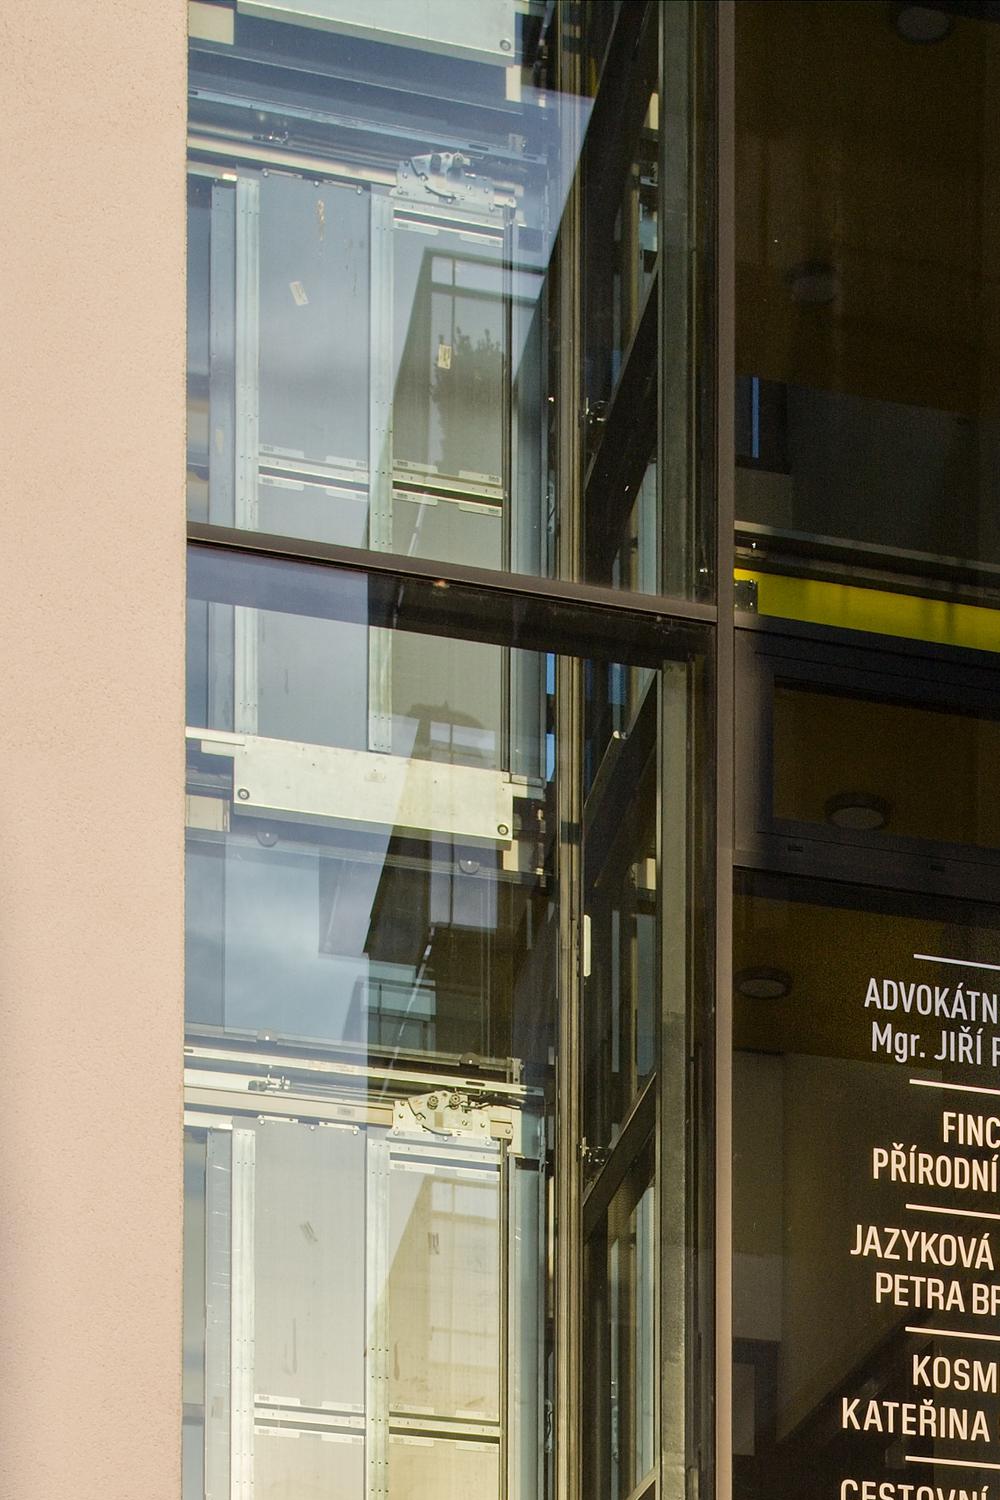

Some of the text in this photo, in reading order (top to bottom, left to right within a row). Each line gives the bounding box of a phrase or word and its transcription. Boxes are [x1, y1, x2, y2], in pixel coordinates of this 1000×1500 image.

[871, 1021, 926, 1063] Mgr.
[934, 1026, 982, 1065] JIŘÍ
[872, 1143, 998, 1193] PŘÍRODNÍ
[850, 1224, 994, 1270] JAZYKOVÁ
[875, 1272, 965, 1312] PETRA
[842, 1397, 990, 1443] KATEŘINA
